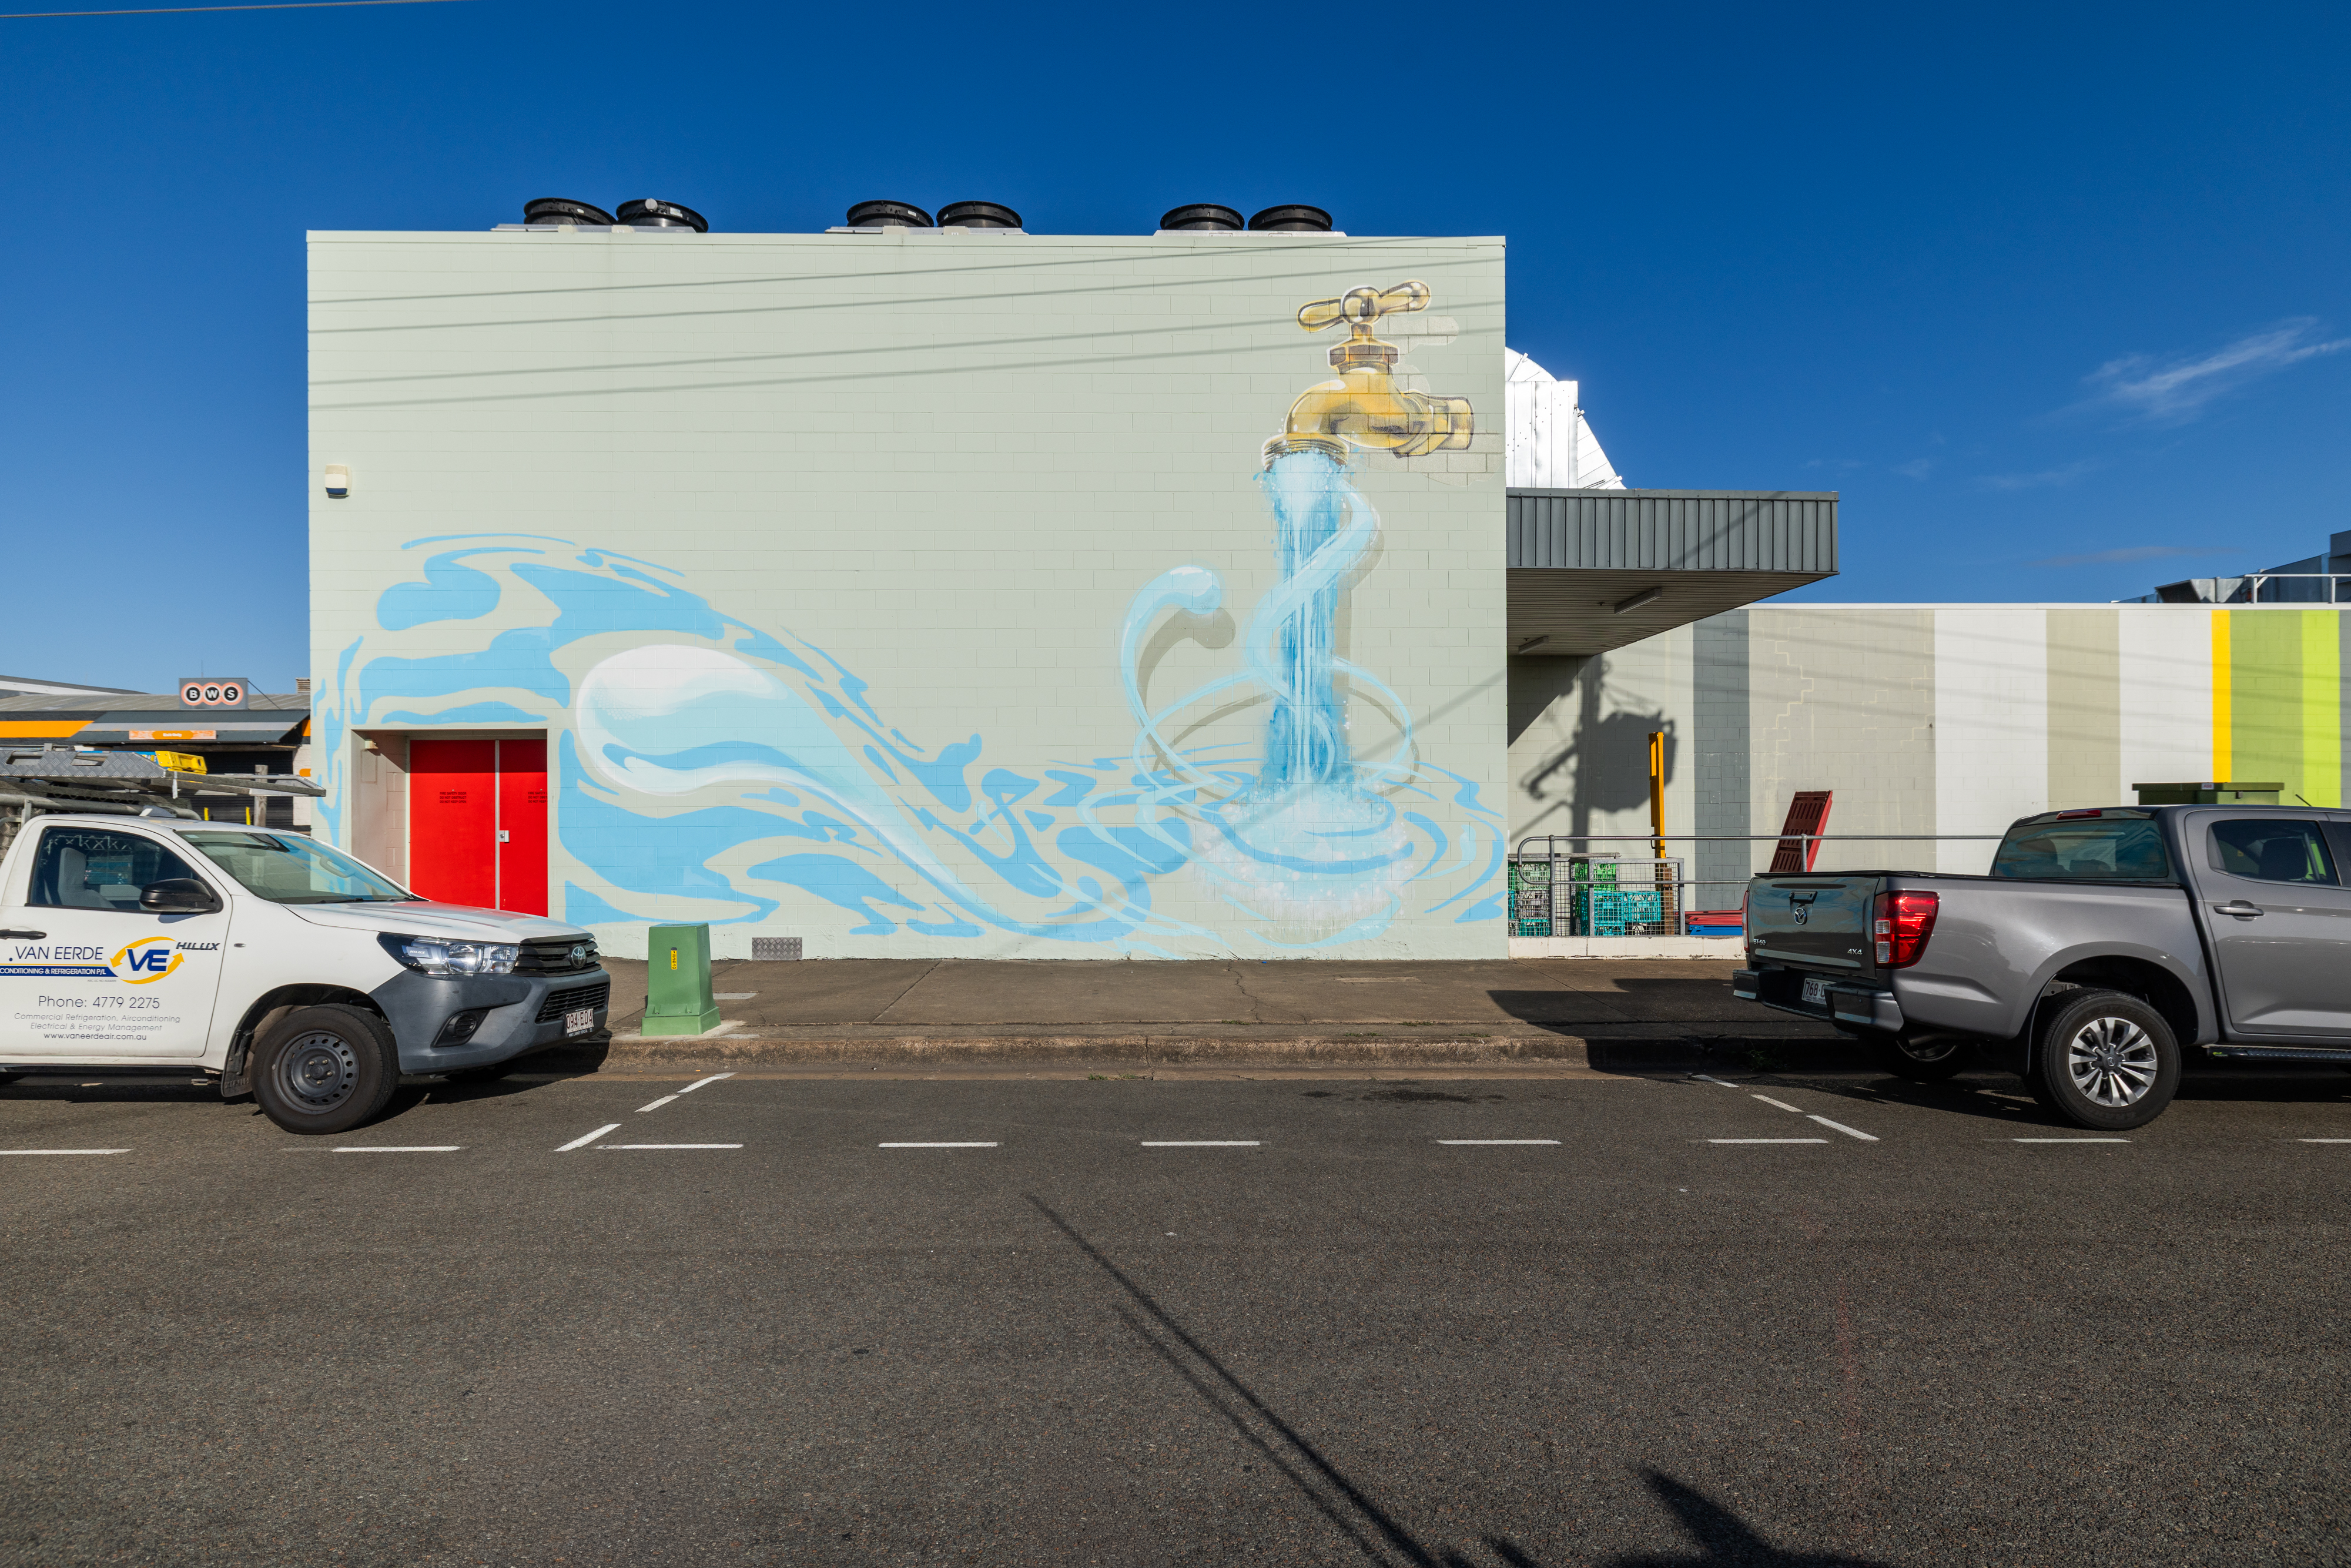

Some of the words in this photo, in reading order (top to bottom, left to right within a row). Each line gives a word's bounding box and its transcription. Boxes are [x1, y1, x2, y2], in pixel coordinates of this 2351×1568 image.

[189, 689, 235, 698] BWS
[175, 942, 220, 950] HILUX
[55, 947, 103, 960] EERDE
[127, 949, 170, 971] VE
[39, 996, 86, 1007] Phone:
[93, 997, 124, 1007] 4779
[129, 997, 160, 1009] 2275
[66, 1014, 118, 1022] Refrigeration,
[121, 1015, 180, 1023] Airconditioning
[108, 1024, 162, 1032] Management
